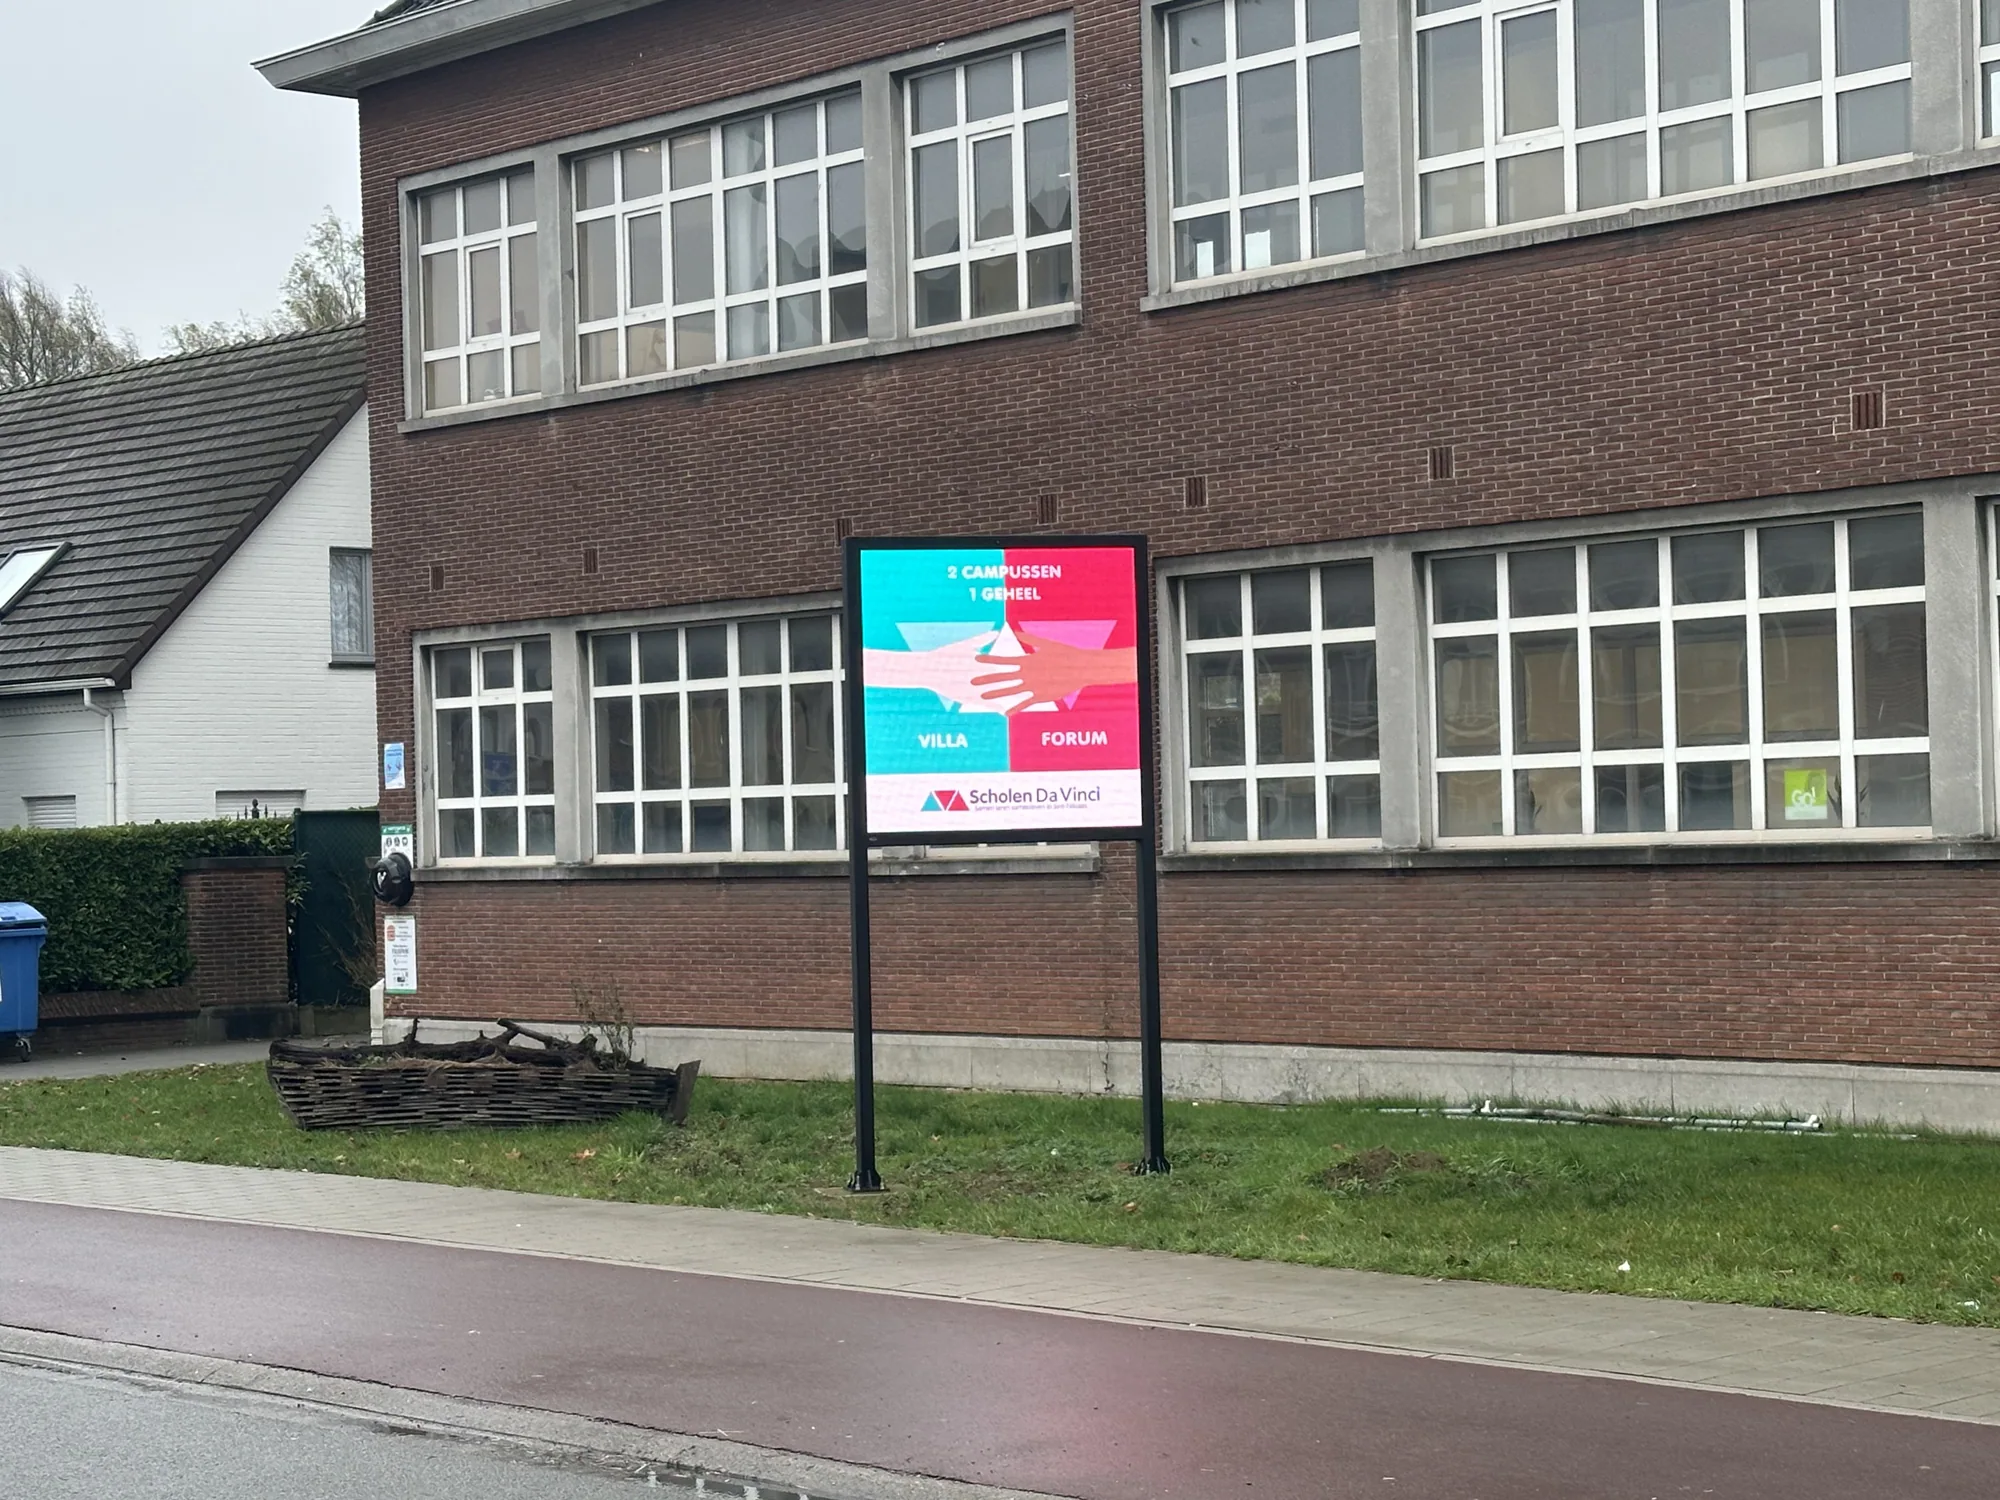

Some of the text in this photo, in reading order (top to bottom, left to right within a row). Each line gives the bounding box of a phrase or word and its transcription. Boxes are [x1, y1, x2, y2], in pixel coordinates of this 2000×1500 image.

[947, 564, 1062, 579] 2 CAMPUSSEN
[969, 586, 1042, 601] 1 GEHEEL
[918, 733, 968, 748] VILLA
[1041, 731, 1108, 746] FORUM
[970, 786, 1101, 804] Scholen Da Vinci
